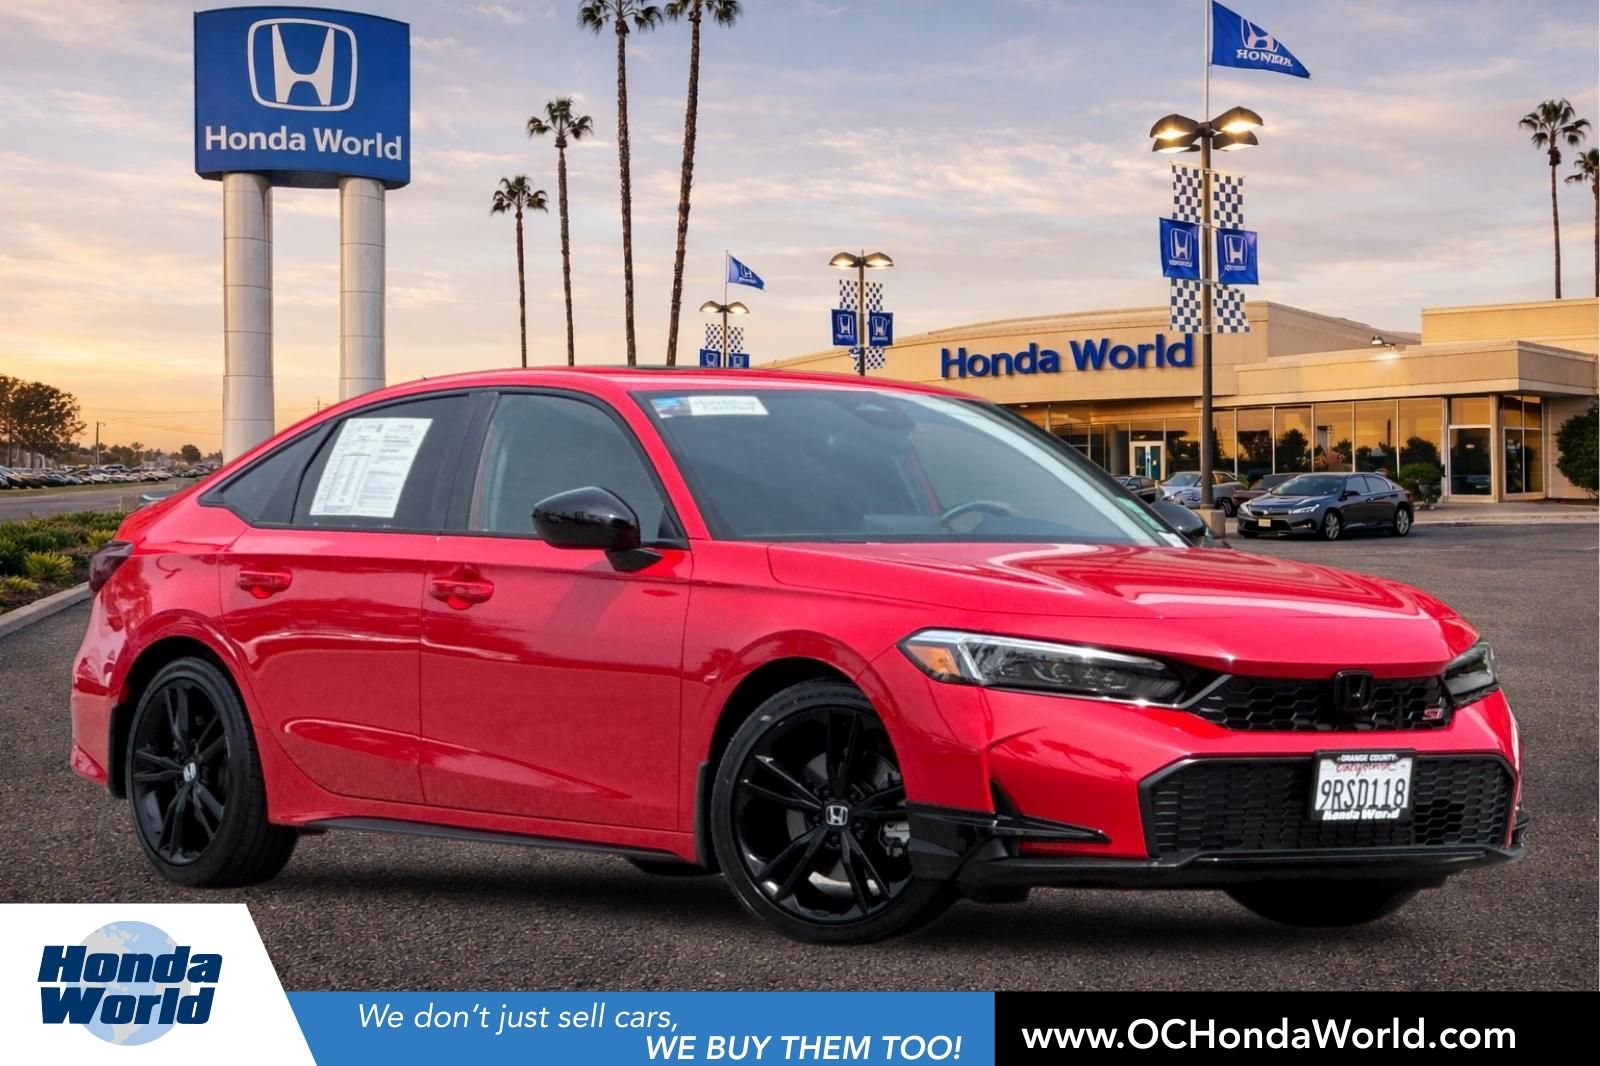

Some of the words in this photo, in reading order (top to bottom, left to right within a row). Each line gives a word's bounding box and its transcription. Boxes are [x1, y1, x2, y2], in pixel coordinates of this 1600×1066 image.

[205, 125, 306, 151] Honda
[313, 127, 402, 160] World
[941, 342, 1061, 378] Honda
[1069, 333, 1194, 371] World
[1320, 778, 1406, 810] 9RSD118
